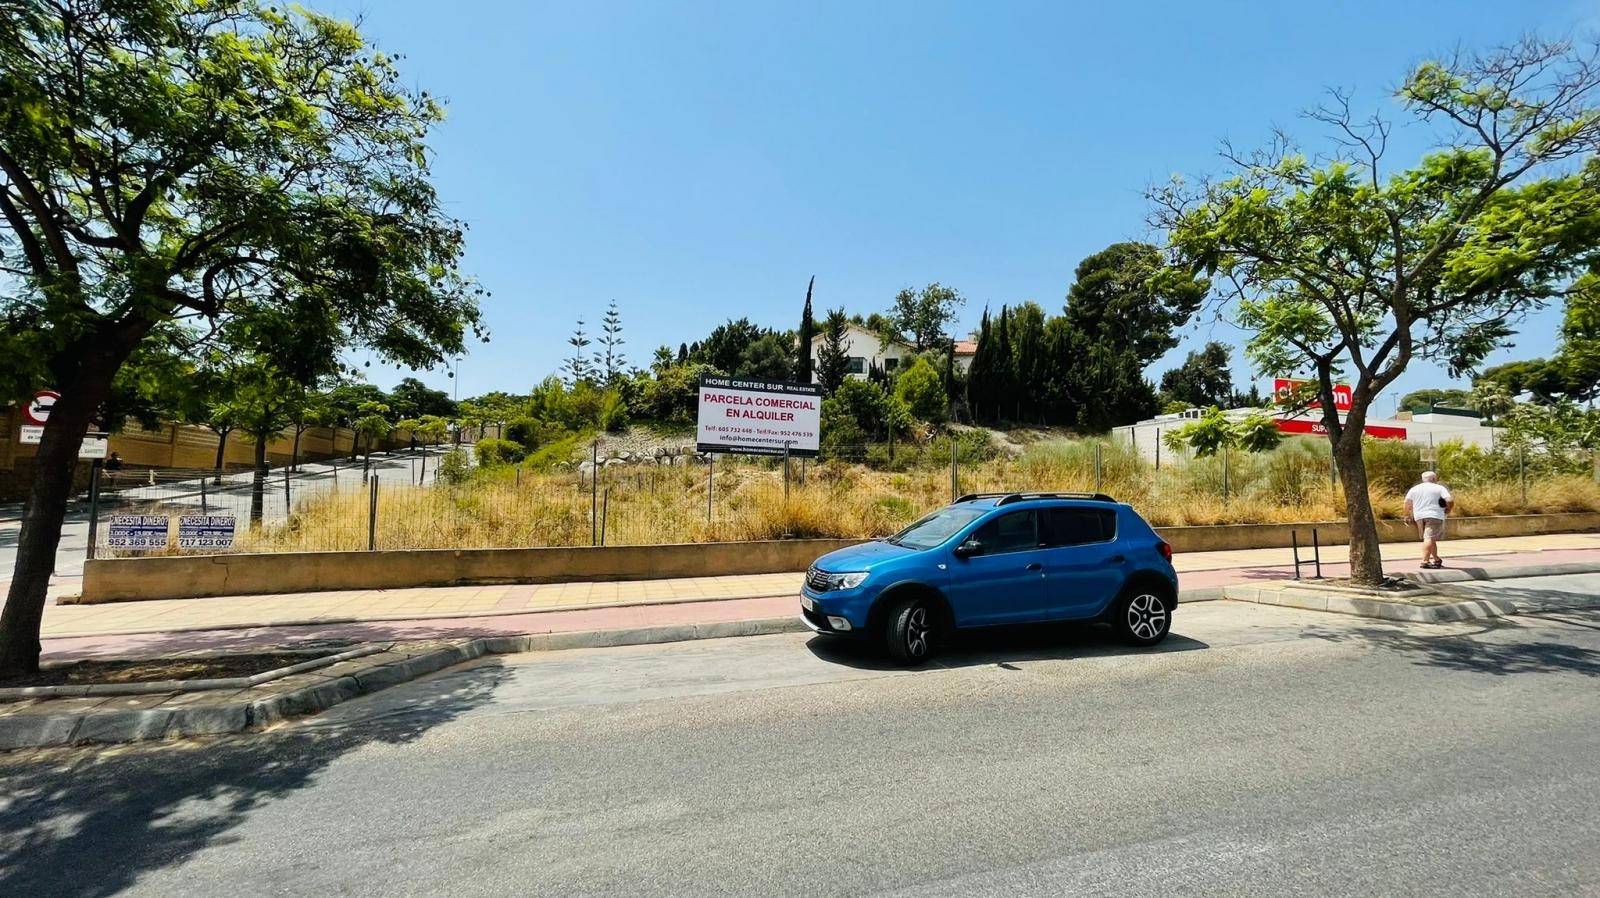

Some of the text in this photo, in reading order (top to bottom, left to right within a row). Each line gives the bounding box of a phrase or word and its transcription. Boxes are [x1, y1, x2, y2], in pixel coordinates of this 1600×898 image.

[705, 378, 730, 386] HOME
[732, 380, 765, 389] CENTER
[704, 394, 816, 410] PARCELA COMERCIAL
[726, 408, 794, 422] EN ALQUILER
[110, 516, 168, 526] ¿NECESITA DINERO?
